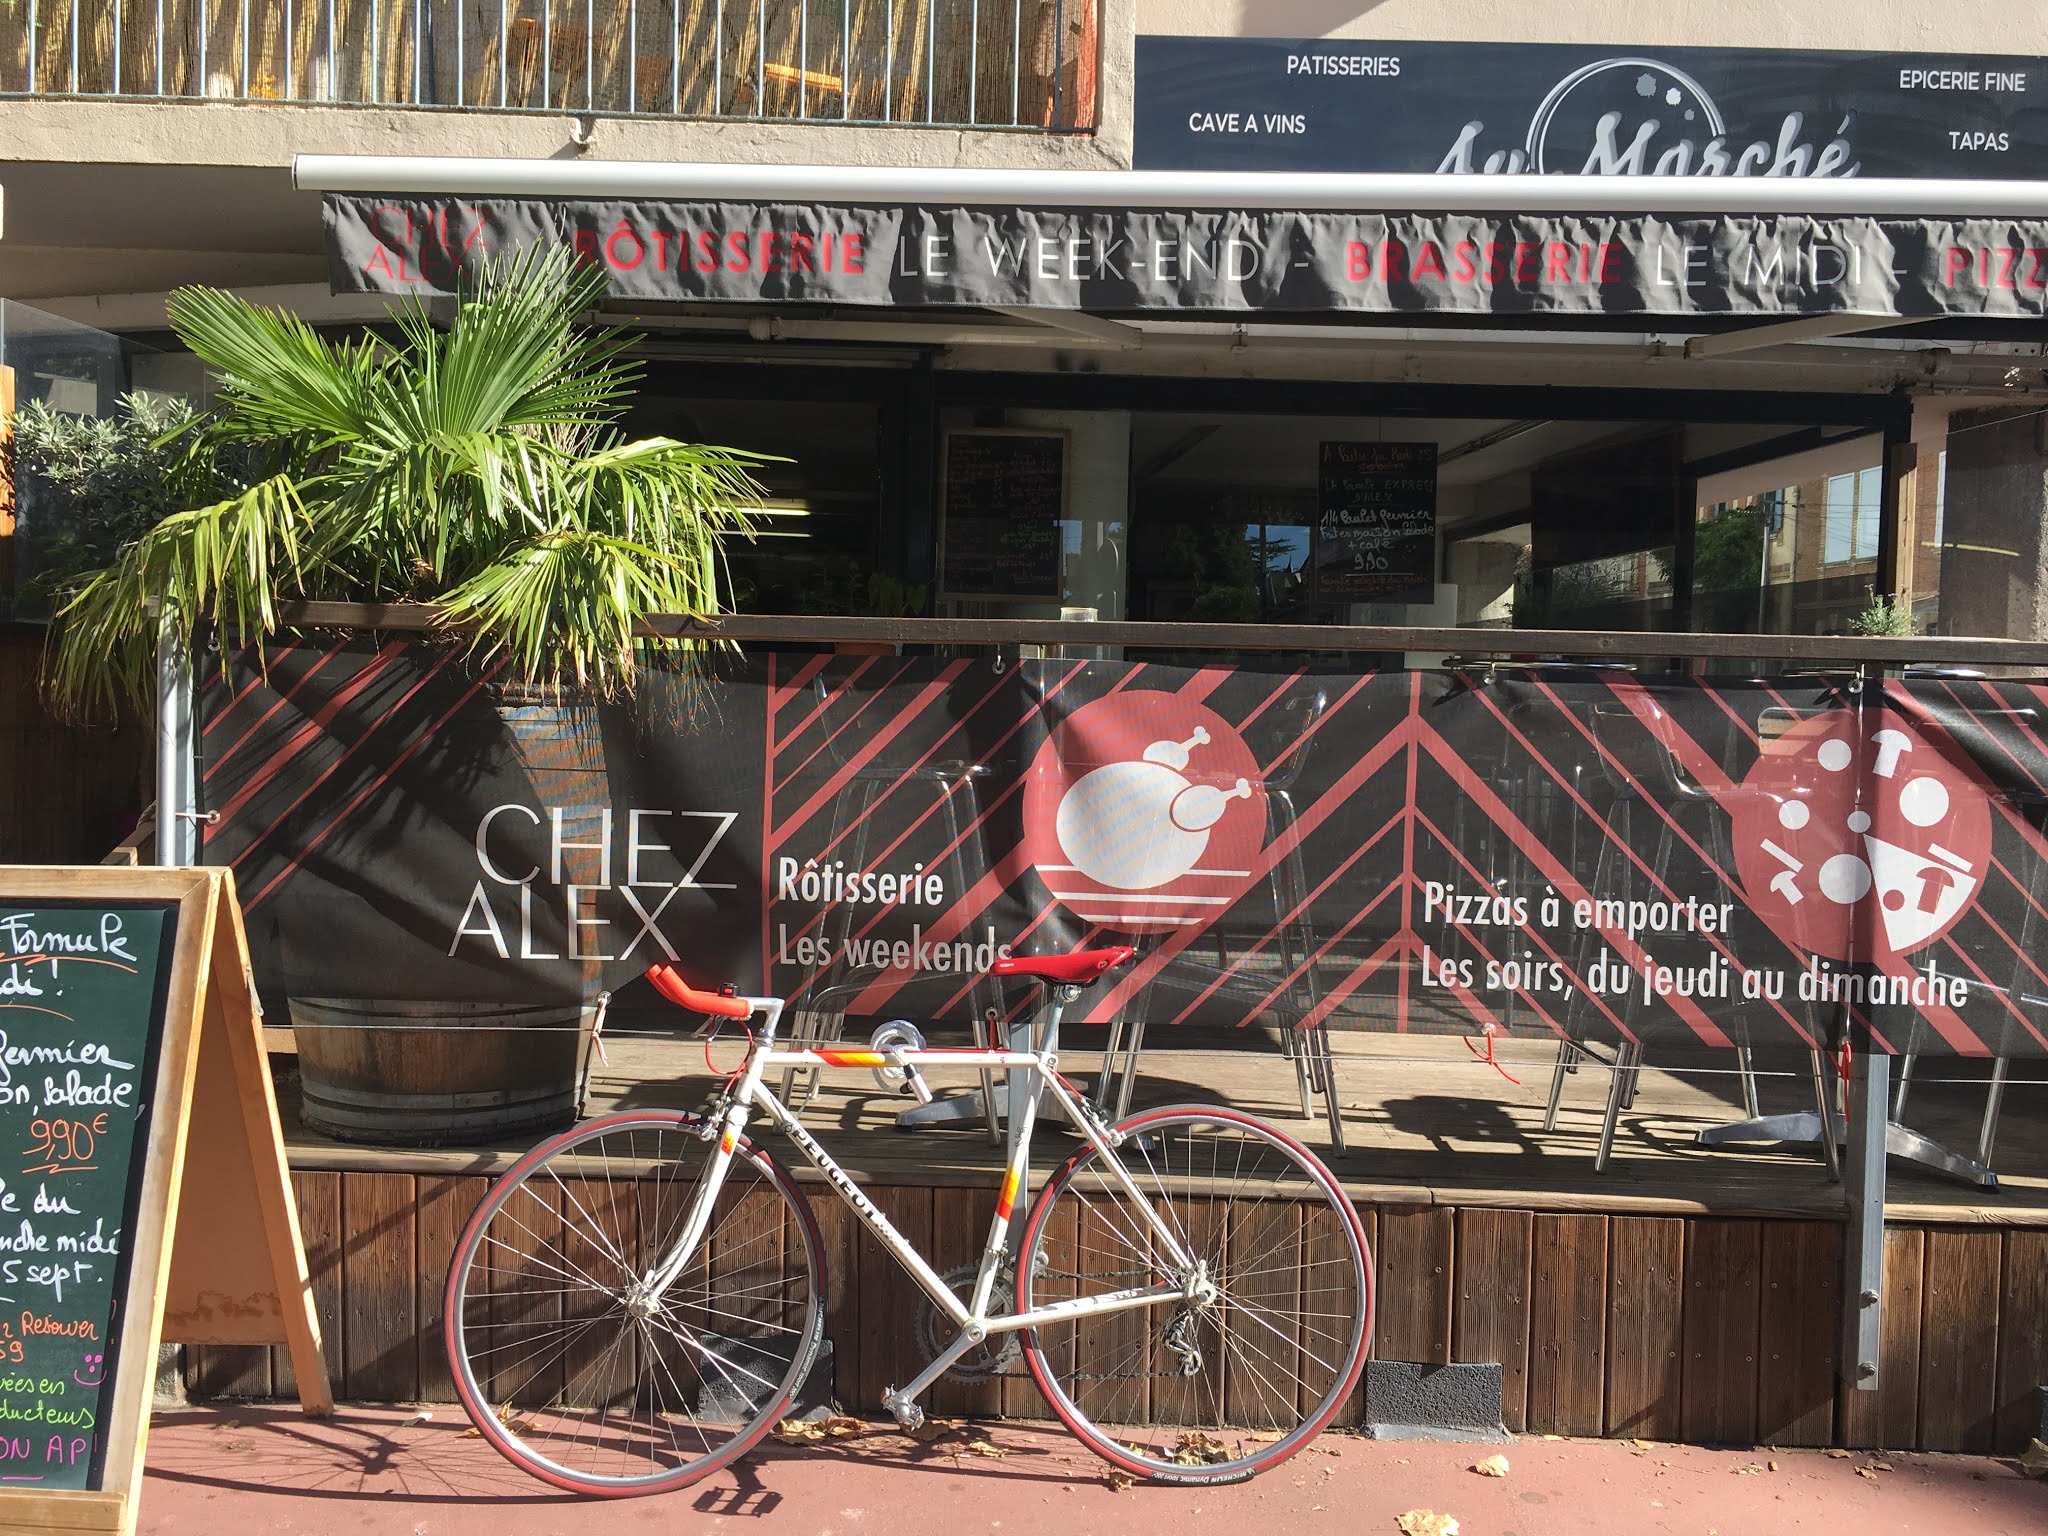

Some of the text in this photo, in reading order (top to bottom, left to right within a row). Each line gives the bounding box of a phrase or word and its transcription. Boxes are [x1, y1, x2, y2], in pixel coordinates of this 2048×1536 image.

[1287, 55, 1401, 77] PATISSERIES
[1900, 70, 2027, 92] EPICERIE FINE
[1189, 112, 1306, 134] CAVE A VINS
[1949, 131, 2009, 152] TAPAS
[370, 205, 492, 248] CHEZ
[364, 243, 470, 283] ALEX
[572, 219, 865, 275] RÔTISSERIE
[900, 235, 949, 277] LE
[984, 235, 1260, 282] WEEK-END
[1347, 240, 1623, 284] BRASSERIE
[1656, 244, 1708, 287] LE
[1743, 244, 1862, 286] MIDI
[1945, 247, 2048, 290] PIZZ
[476, 803, 739, 890] CHEZ
[778, 857, 945, 907] Rôtisserie
[448, 880, 683, 963] ALEX
[1424, 881, 1735, 941] Pizzas à emporter
[779, 924, 832, 966] Les
[1422, 946, 1969, 1008] Les soirs, du jeudi au dimanche
[792, 1127, 875, 1220] PEUGEOT
